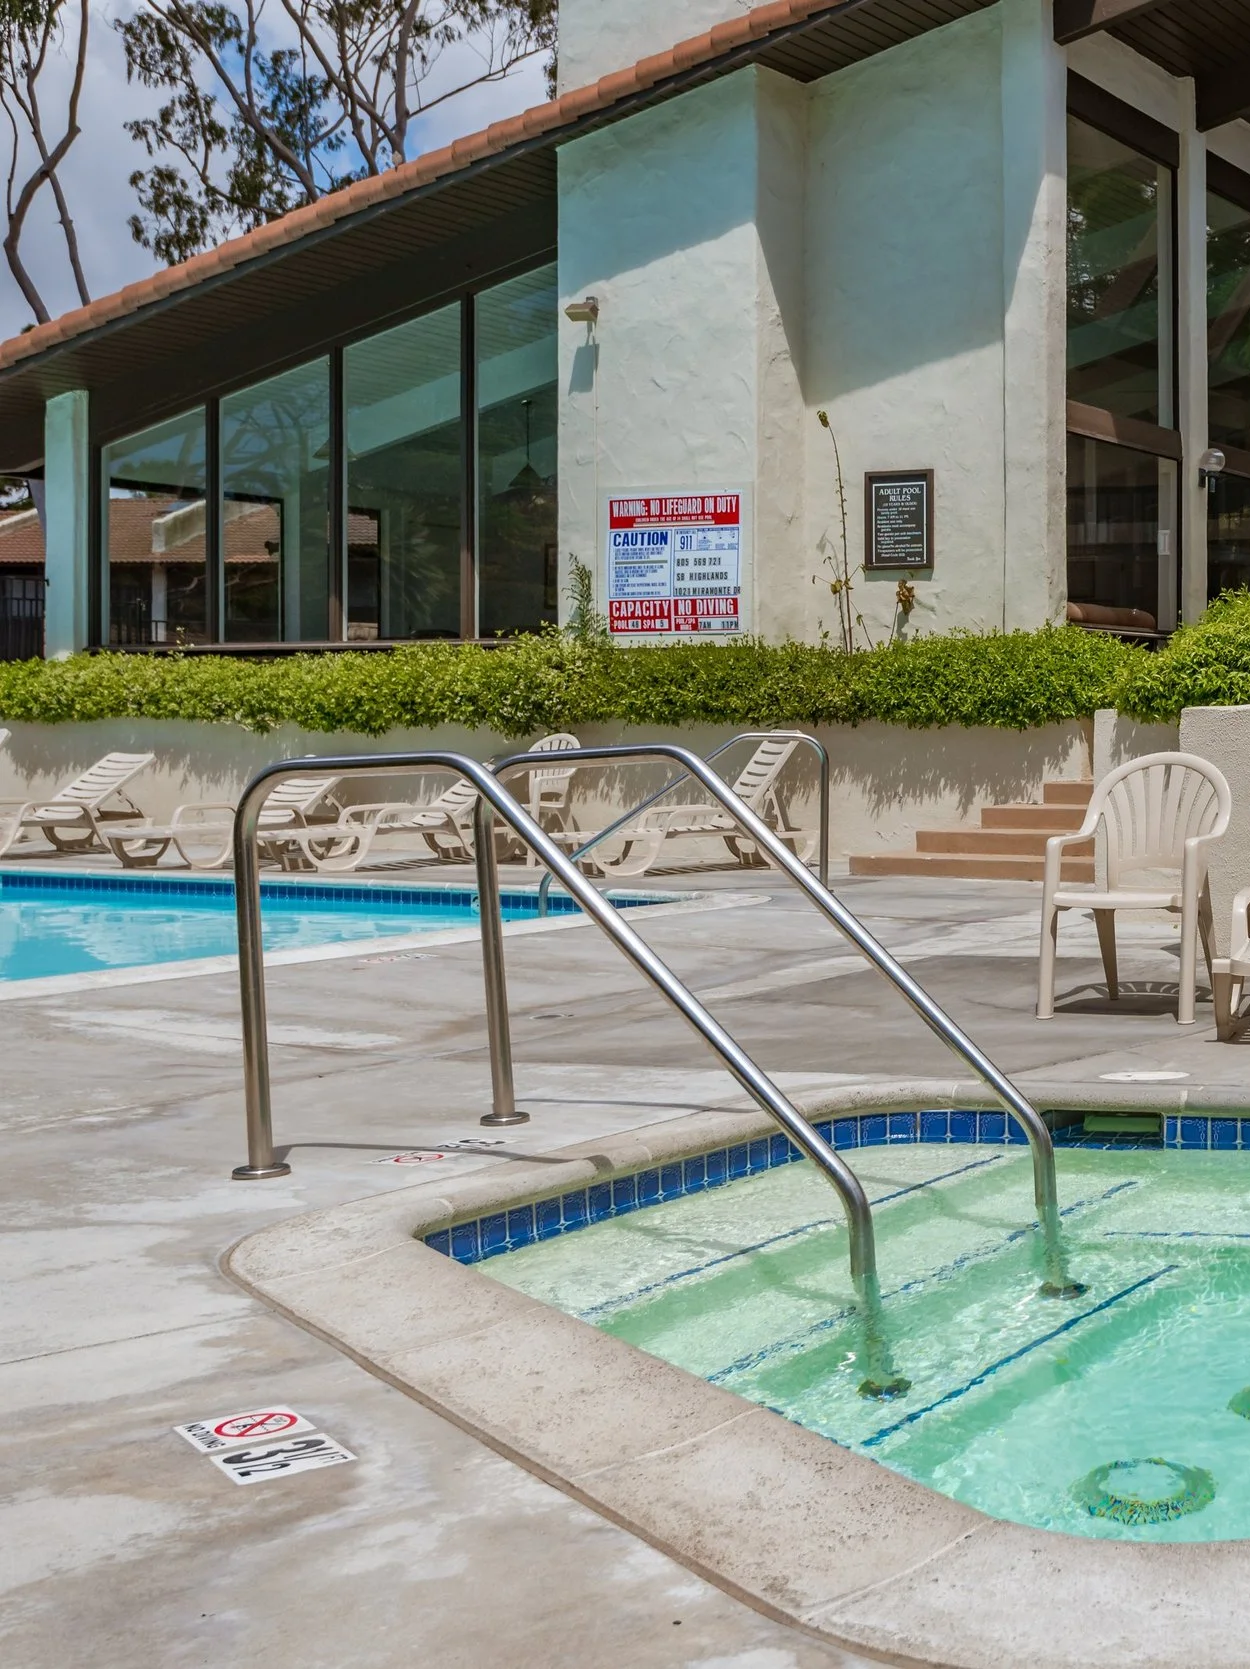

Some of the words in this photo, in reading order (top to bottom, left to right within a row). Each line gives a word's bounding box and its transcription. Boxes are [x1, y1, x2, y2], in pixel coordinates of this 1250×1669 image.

[612, 500, 649, 518] WARNING:
[650, 500, 660, 516] NO
[662, 498, 702, 515] LIFEGUARD
[704, 497, 715, 514] ON
[717, 496, 737, 513] DUTY
[613, 531, 669, 547] CAUTION
[680, 535, 693, 550] 911
[676, 558, 690, 567] 805
[689, 571, 729, 581] HIGHLANDS
[733, 585, 741, 595] DR
[612, 600, 670, 617] CAPACITY
[678, 600, 692, 615] NO
[696, 598, 734, 615] DIVING
[613, 619, 628, 630] POOL
[642, 619, 656, 630] SPA
[184, 1423, 205, 1432] NO
[191, 1430, 226, 1448] DIVING
